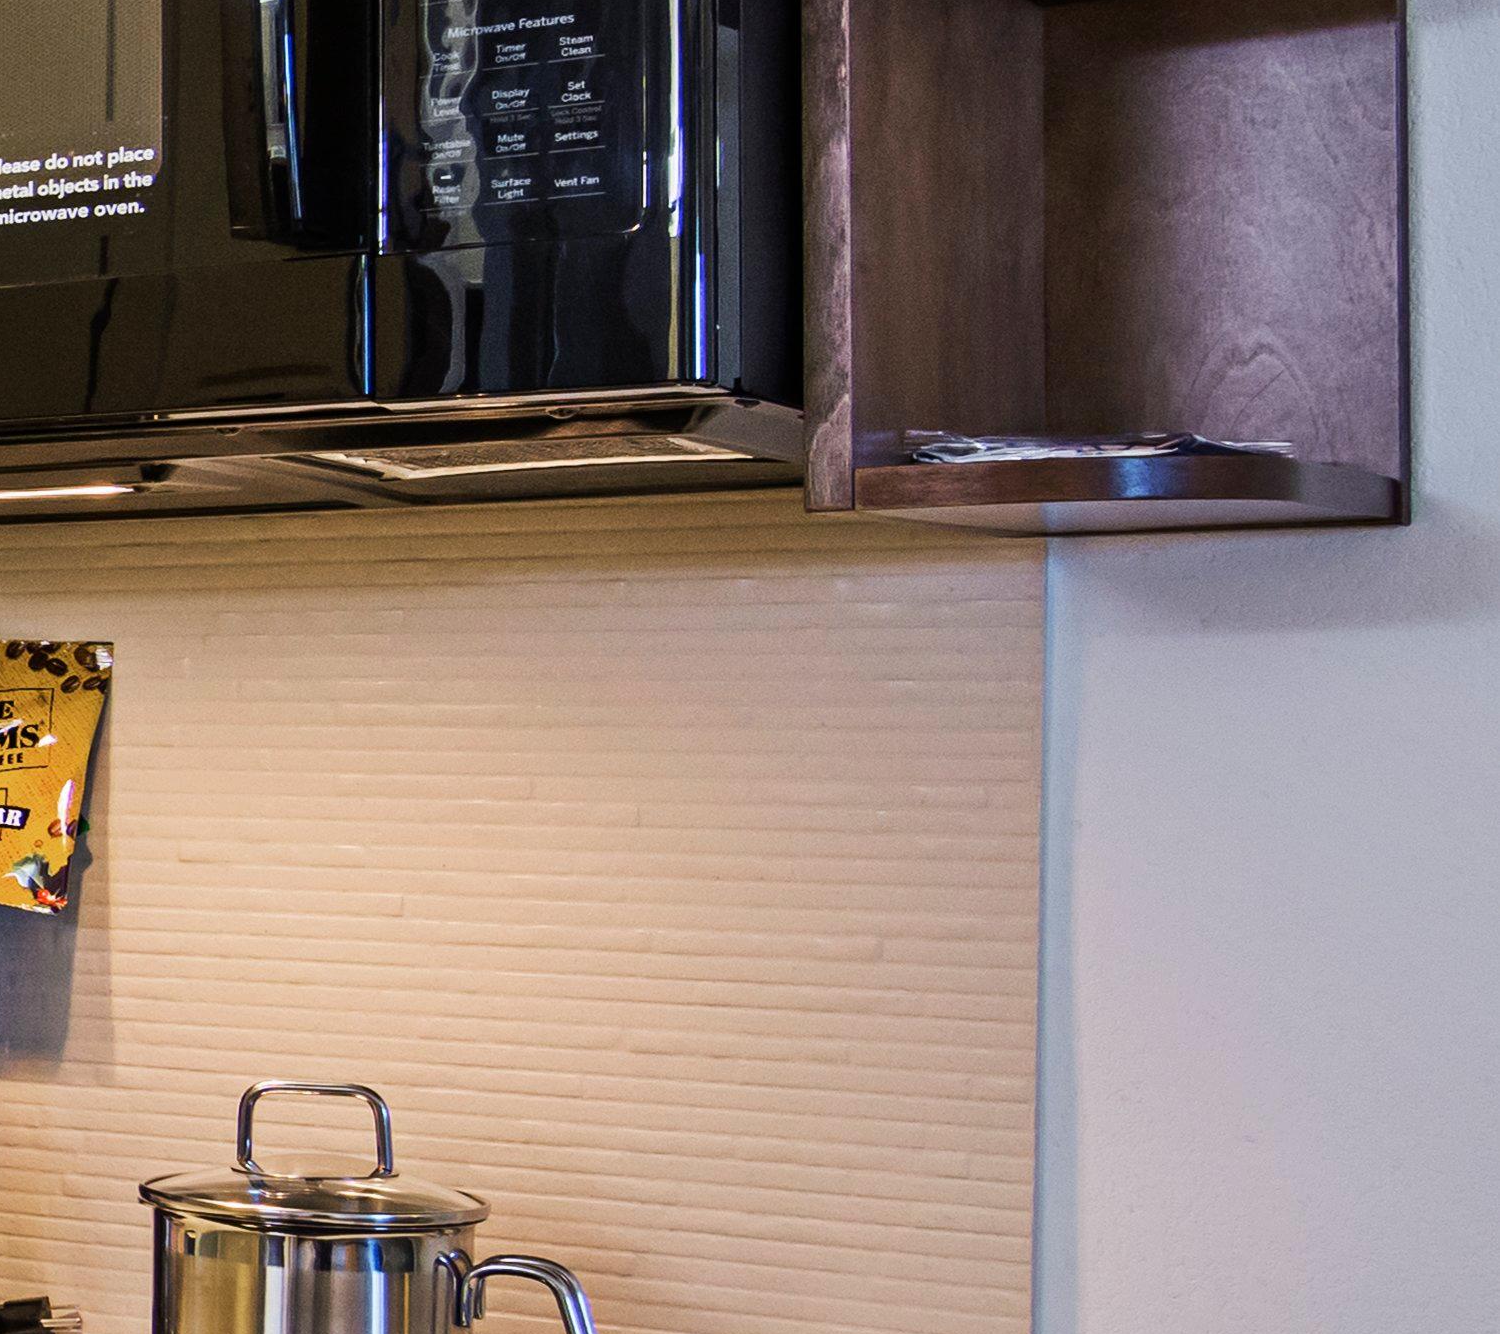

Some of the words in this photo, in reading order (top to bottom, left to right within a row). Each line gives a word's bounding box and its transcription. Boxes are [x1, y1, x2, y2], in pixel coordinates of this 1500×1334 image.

[448, 22, 516, 39] Microwave
[519, 14, 575, 29] Features
[496, 43, 526, 53] Timer
[559, 34, 594, 46] Steam
[561, 46, 591, 57] Clean
[491, 88, 530, 101] Display
[568, 80, 586, 91] Set
[561, 92, 591, 103] Clock
[498, 133, 525, 143] Mute
[554, 129, 598, 142] Settings
[44, 153, 69, 170] do
[73, 151, 103, 167] not
[107, 146, 155, 168] place
[37, 178, 99, 199] objects
[103, 174, 119, 190] in
[123, 171, 153, 188] the
[491, 177, 531, 188] Surface
[554, 177, 578, 188] Vent
[581, 175, 600, 185] Fan
[498, 189, 524, 200] Light
[94, 201, 145, 216] oven.
